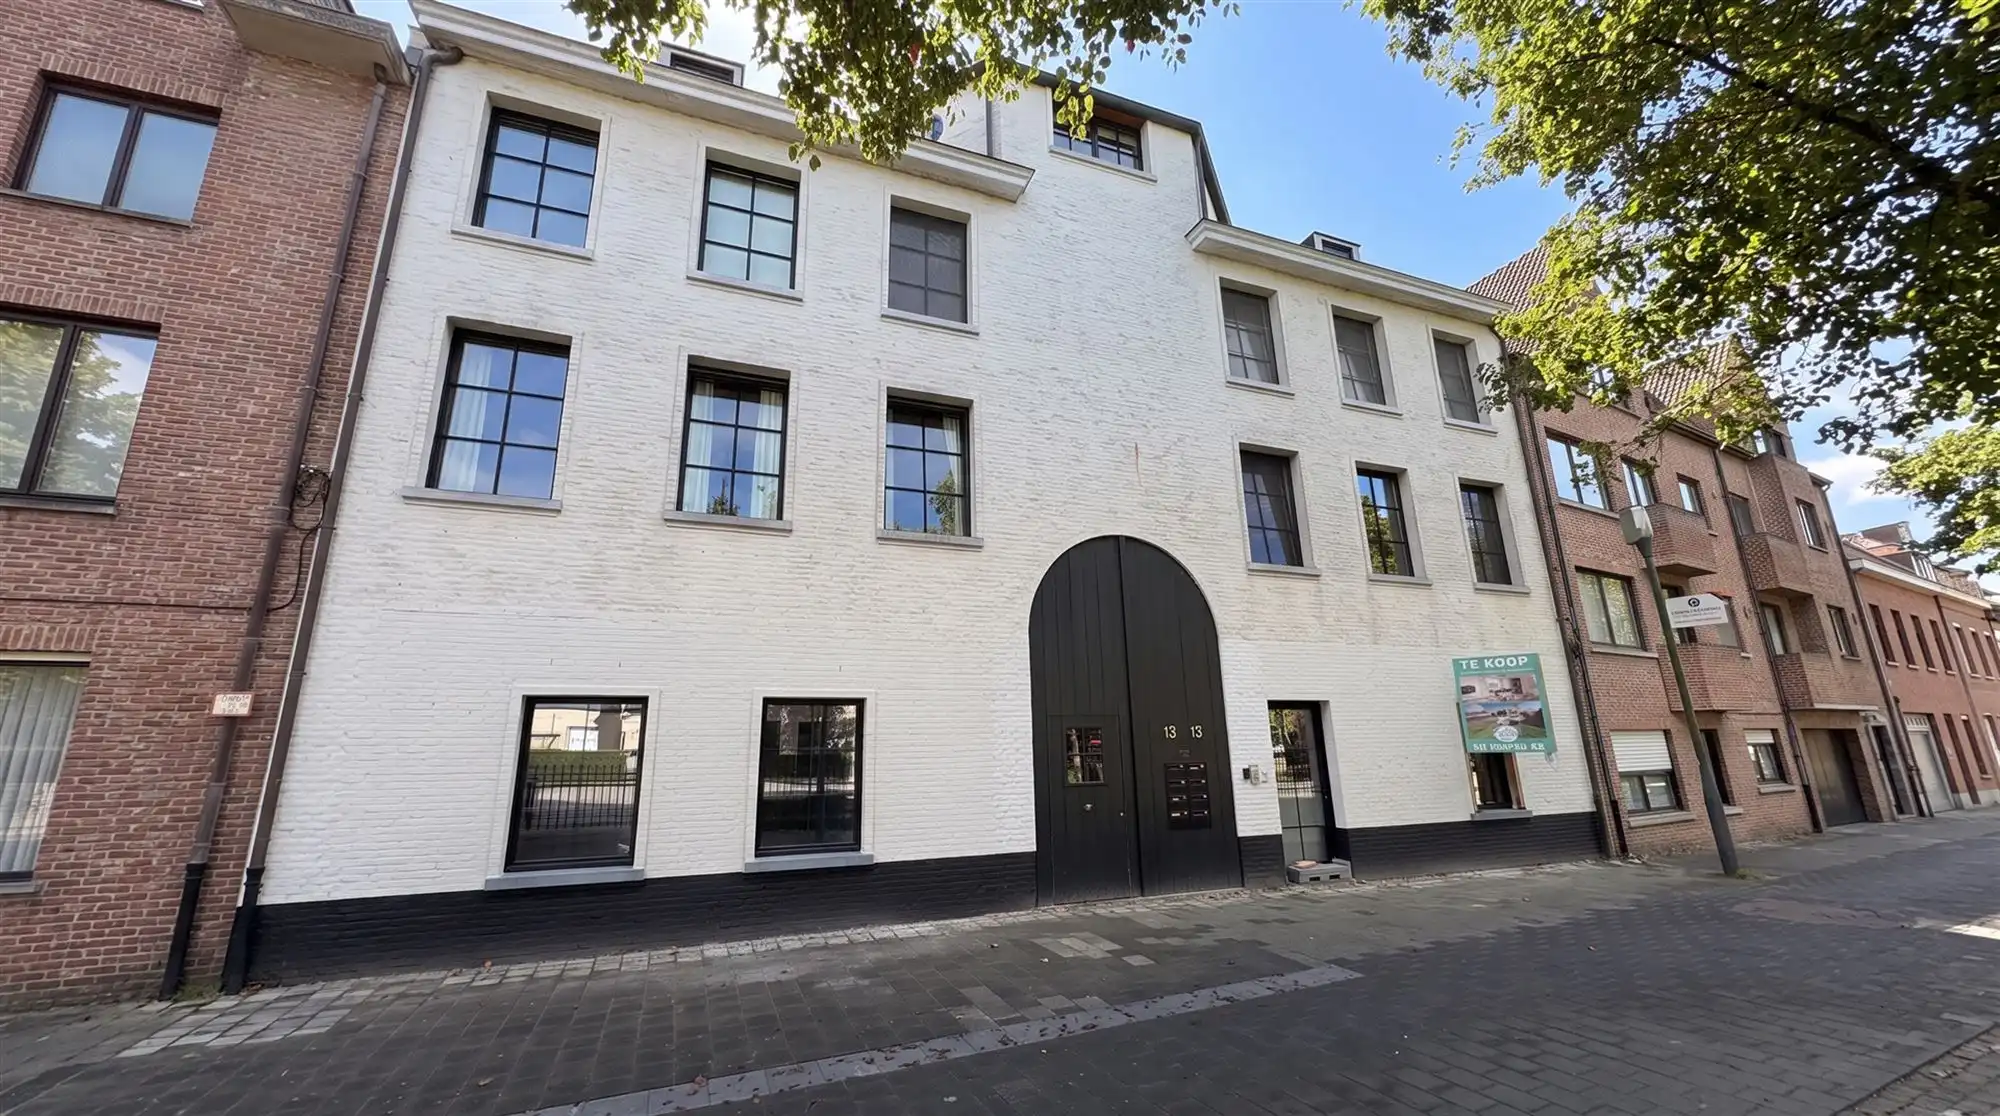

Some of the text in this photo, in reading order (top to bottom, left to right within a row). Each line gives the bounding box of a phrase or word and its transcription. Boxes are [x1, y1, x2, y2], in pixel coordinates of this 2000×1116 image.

[1459, 656, 1528, 670] TE KOOP
[1163, 725, 1177, 739] 13
[1190, 725, 1203, 738] 13
